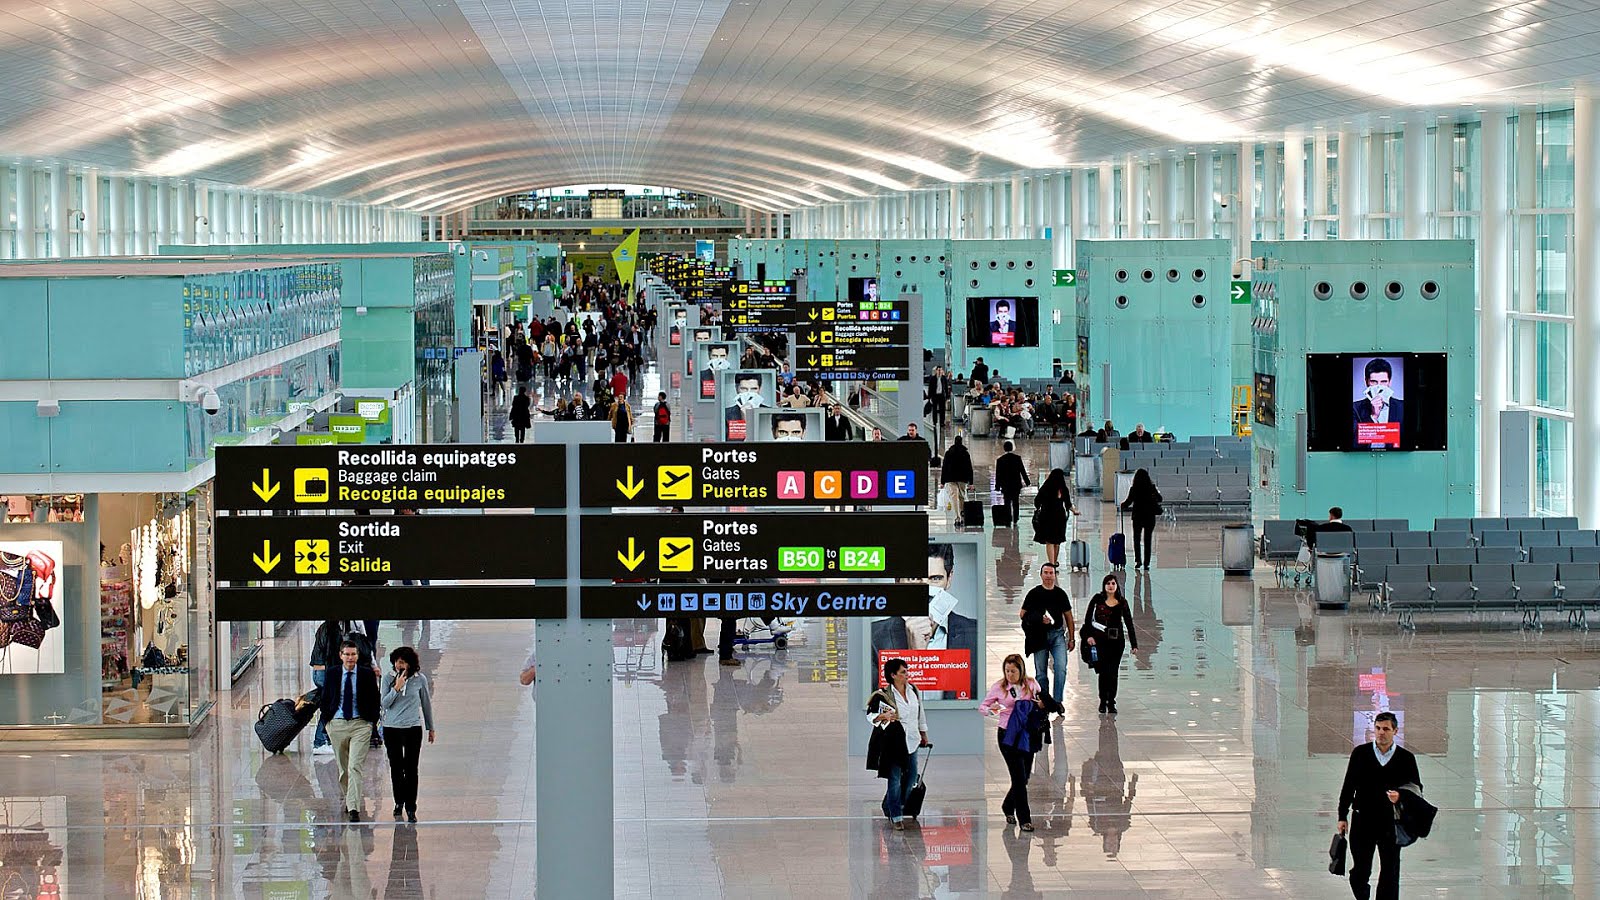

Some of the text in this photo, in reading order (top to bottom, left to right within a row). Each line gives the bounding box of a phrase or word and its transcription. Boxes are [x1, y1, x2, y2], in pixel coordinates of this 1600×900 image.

[857, 372, 870, 380] Sky
[339, 450, 516, 468] Recollida equipatges
[703, 448, 756, 463] Portes
[339, 469, 436, 485] Baggage claim
[702, 467, 739, 479] Gates
[703, 484, 767, 498] Puertas
[783, 475, 907, 494] A C D E
[339, 486, 504, 503] Recogida equipajes
[339, 522, 399, 536] Sortida
[703, 520, 757, 534] Portes
[339, 541, 363, 553] Exit
[703, 539, 740, 551] Gates
[340, 557, 390, 572] Salida
[704, 556, 767, 569] Puertas
[783, 549, 881, 567] B50 to B24
[827, 560, 835, 569] a
[771, 592, 886, 614] Sky Centre
